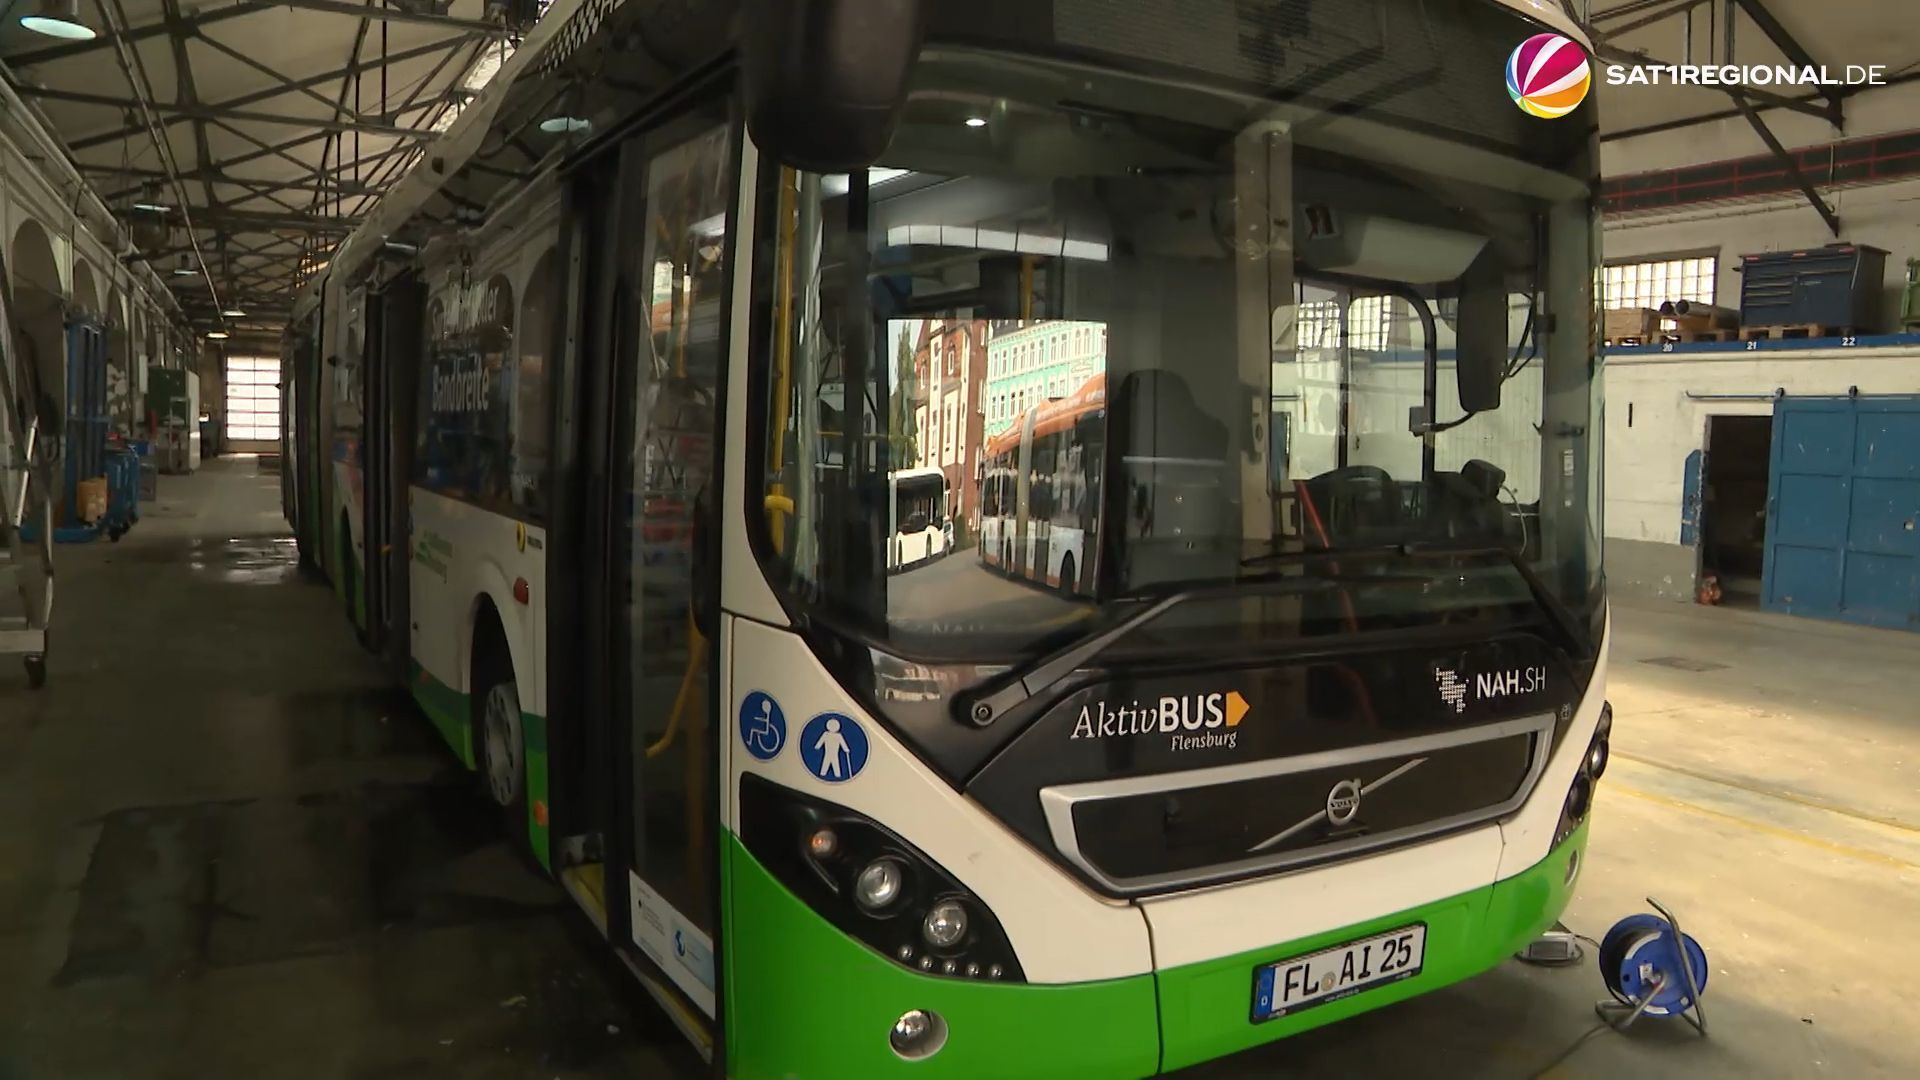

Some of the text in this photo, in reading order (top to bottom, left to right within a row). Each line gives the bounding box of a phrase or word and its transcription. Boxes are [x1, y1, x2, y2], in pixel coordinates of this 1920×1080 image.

[1662, 343, 1673, 352] 20
[1747, 341, 1757, 350] 21
[1842, 336, 1856, 346] 22
[432, 353, 490, 412] Bandbreite
[1476, 666, 1546, 699] NAH.SH
[1070, 692, 1224, 740] AktivBUS
[1171, 731, 1238, 752] Flensburg
[1283, 933, 1413, 1002] FL AI 25
